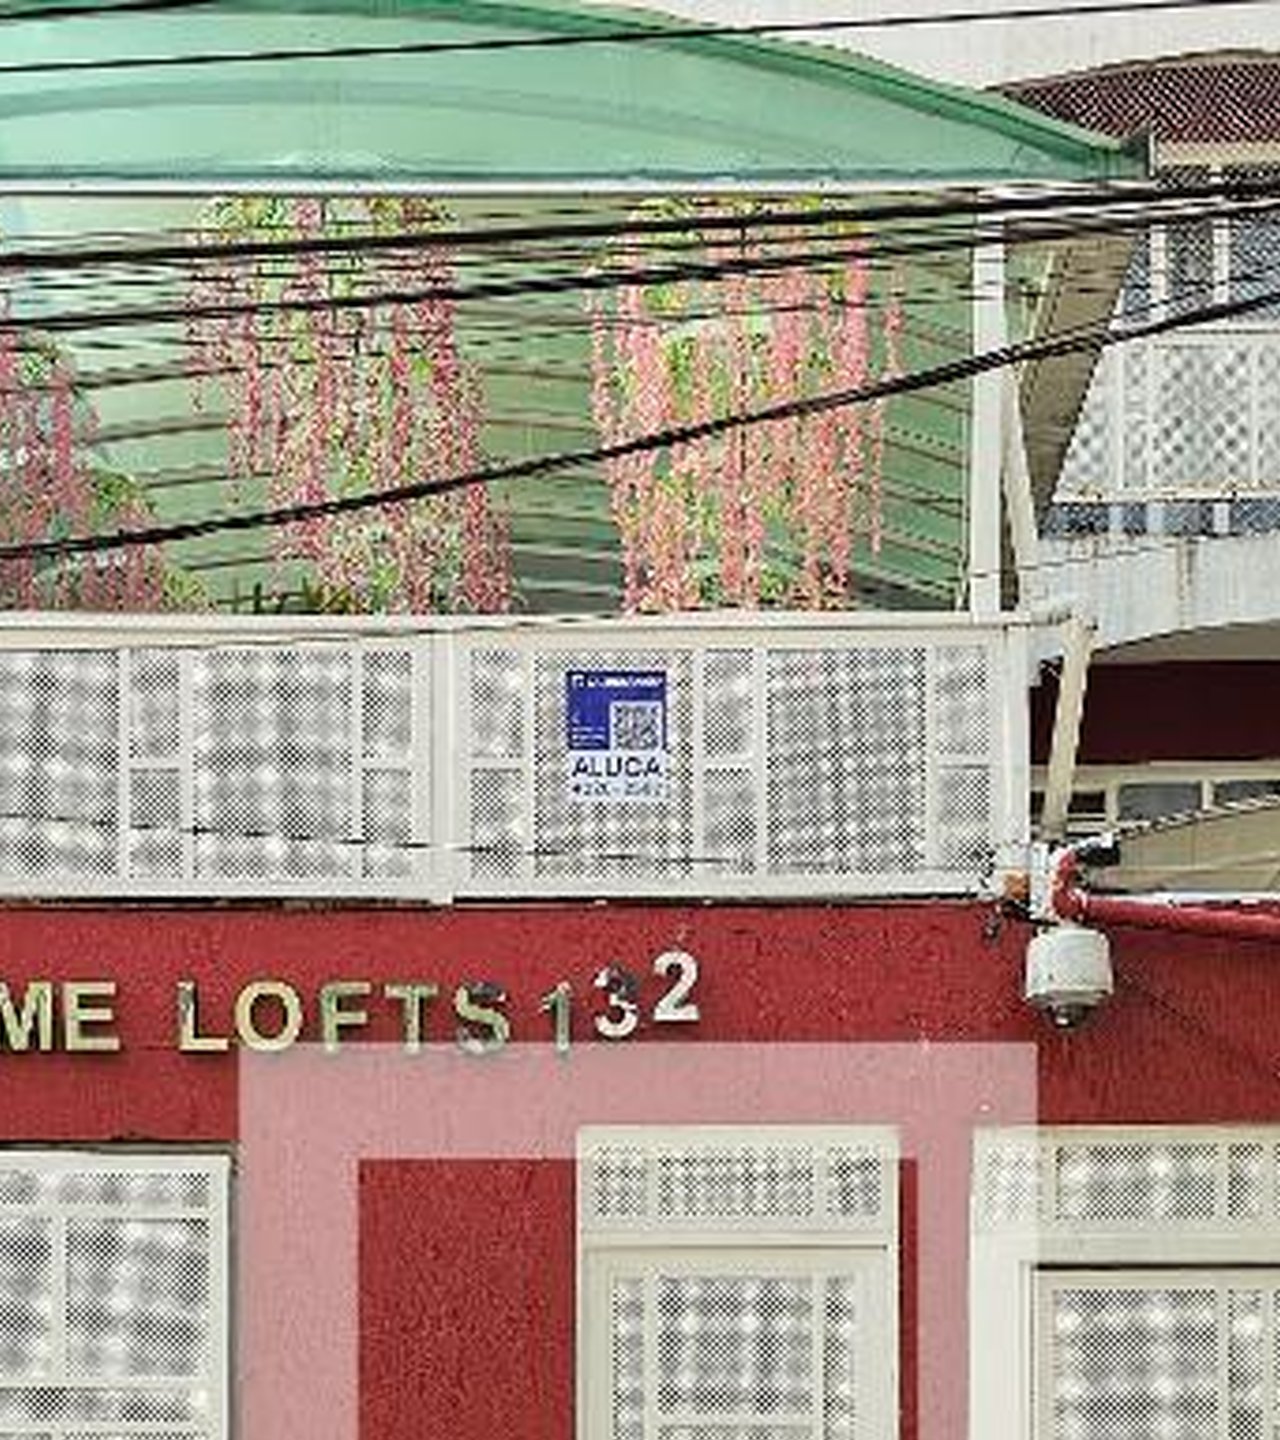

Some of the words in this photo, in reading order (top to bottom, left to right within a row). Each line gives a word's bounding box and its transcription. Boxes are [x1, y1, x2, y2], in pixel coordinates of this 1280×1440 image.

[572, 756, 664, 777] ALUCA
[176, 980, 510, 1053] LOFTS
[539, 950, 700, 1053] 132
